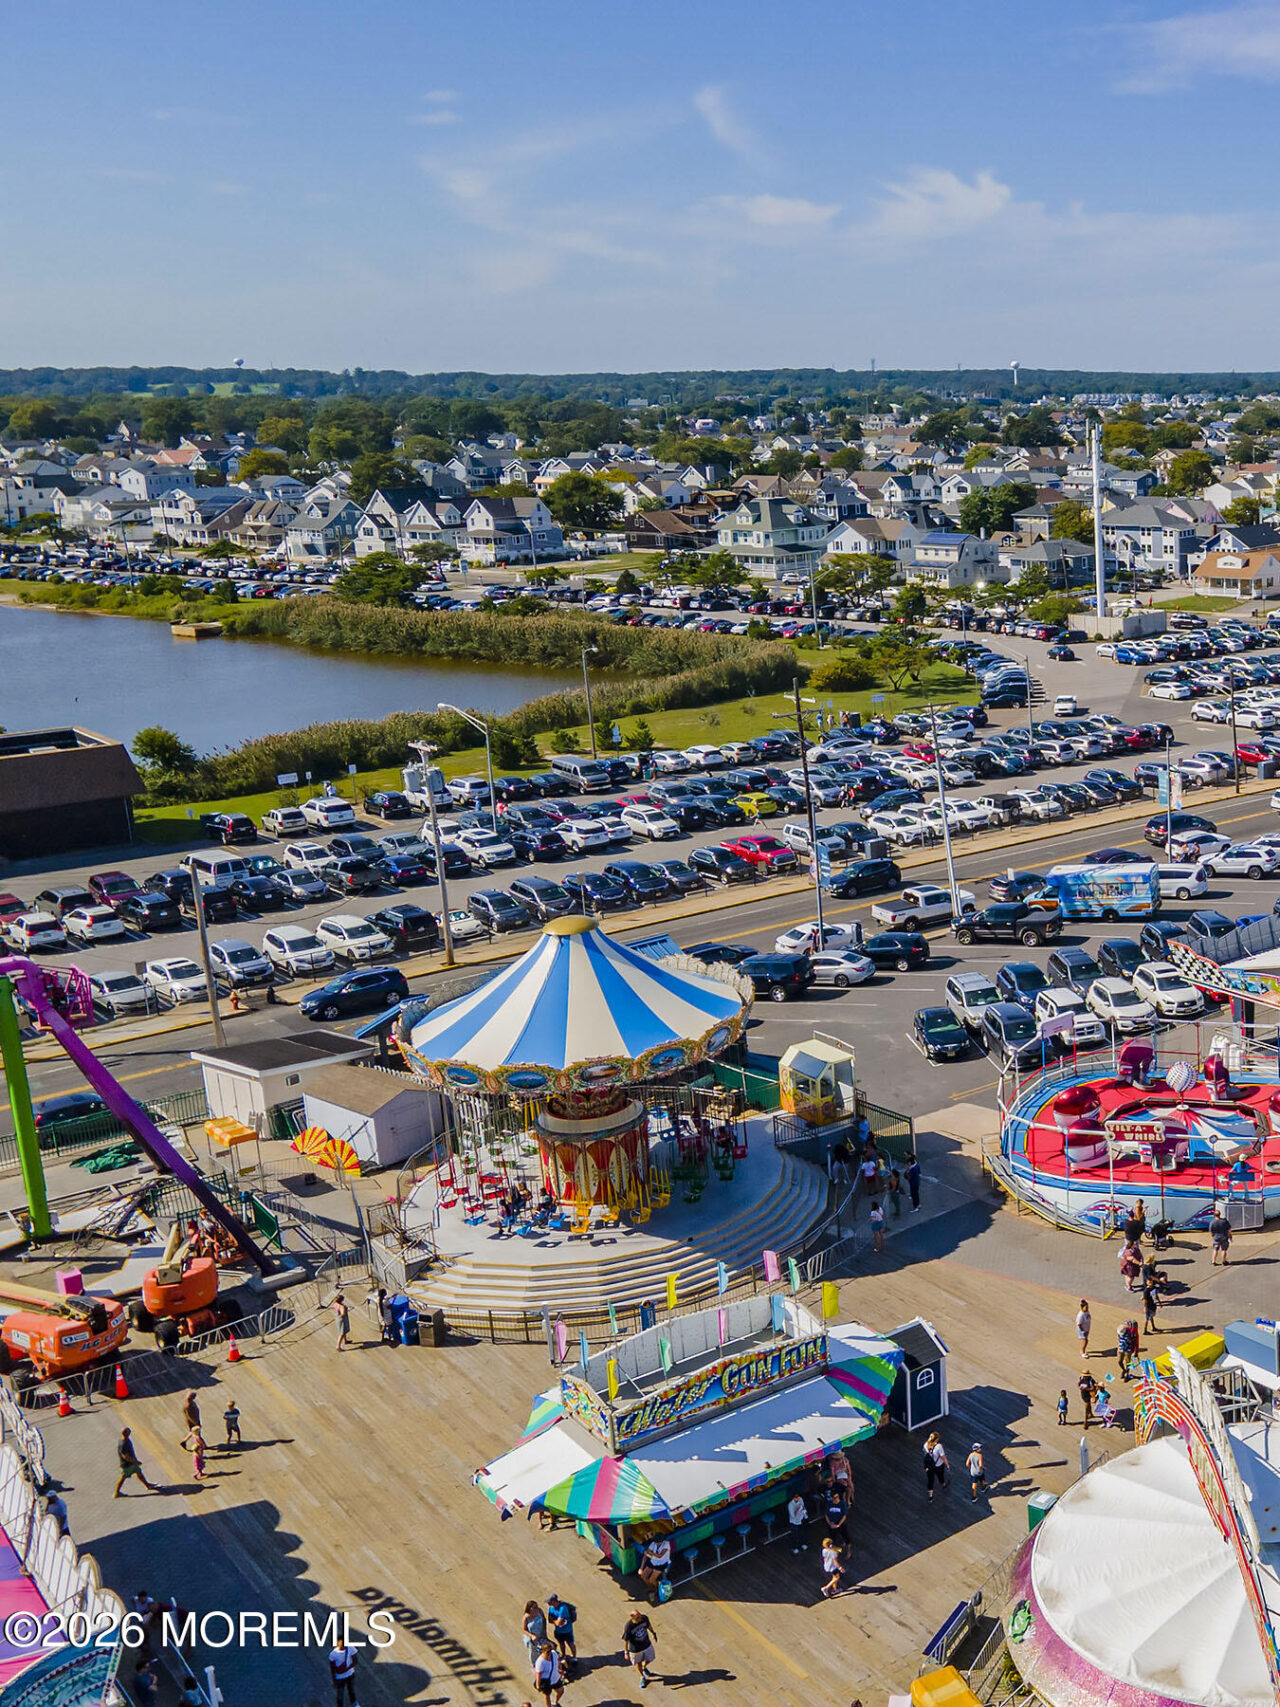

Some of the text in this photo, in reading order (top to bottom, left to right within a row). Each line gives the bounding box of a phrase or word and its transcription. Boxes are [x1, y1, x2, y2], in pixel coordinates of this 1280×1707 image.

[1123, 1133, 1162, 1141] WHIRL
[81, 1340, 100, 1351] JLG
[620, 1336, 824, 1436] Water GUN FUN
